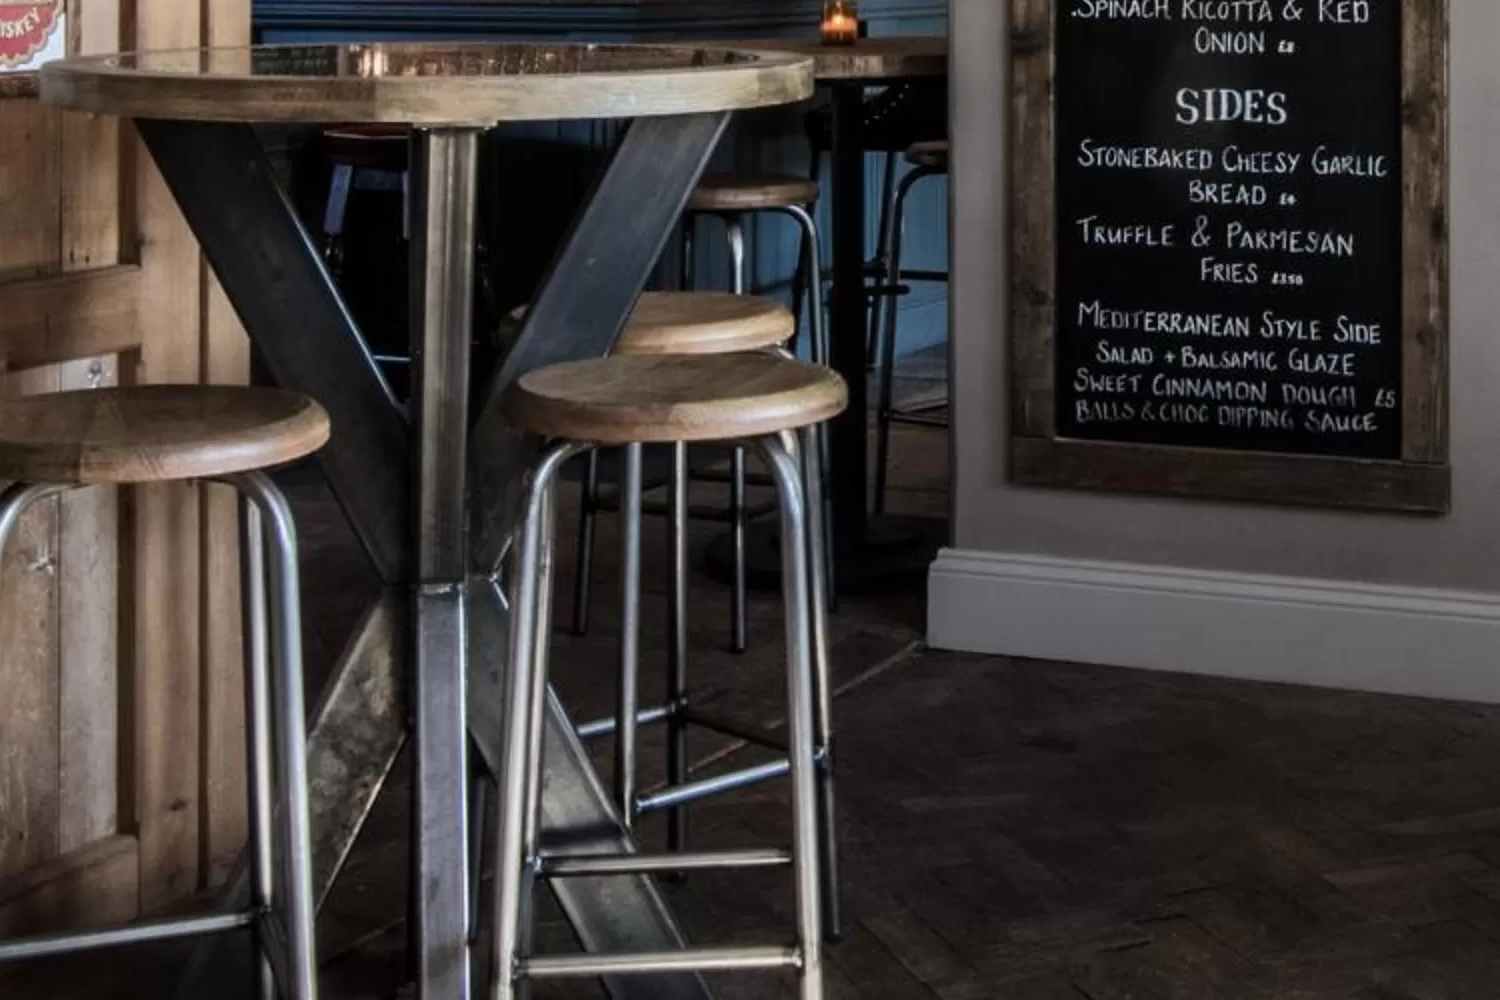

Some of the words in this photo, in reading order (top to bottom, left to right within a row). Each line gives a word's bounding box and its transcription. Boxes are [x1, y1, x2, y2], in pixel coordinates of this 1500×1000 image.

[1194, 25, 1265, 55] ONION
[1175, 87, 1287, 125] SIDES
[1077, 138, 1213, 171] STONEBAKED
[1221, 144, 1301, 174] CHEESY
[1311, 145, 1387, 178] GARLIC
[1188, 179, 1267, 206] BREAD
[1075, 215, 1173, 247] TRUFFLE
[1190, 214, 1212, 248] &
[1226, 221, 1354, 257] PARMESAN
[1200, 256, 1259, 284] FRIES
[1077, 299, 1250, 338] MEDITERRANEAN
[1259, 310, 1321, 341] STYLE
[1333, 314, 1381, 345] SIDE
[1095, 339, 1154, 365] SALAD
[1180, 345, 1278, 372] BALSAMIC
[1287, 347, 1355, 377] GLAZE
[1073, 367, 1143, 393] SWEET
[1151, 372, 1267, 406] CINNAMON
[1281, 383, 1356, 407] DOUGH
[1374, 388, 1396, 409] £5
[1075, 398, 1136, 423] BALLS
[1159, 403, 1209, 423] CHOC
[1217, 404, 1294, 429] DIPPING
[1304, 409, 1378, 433] SAUCE
